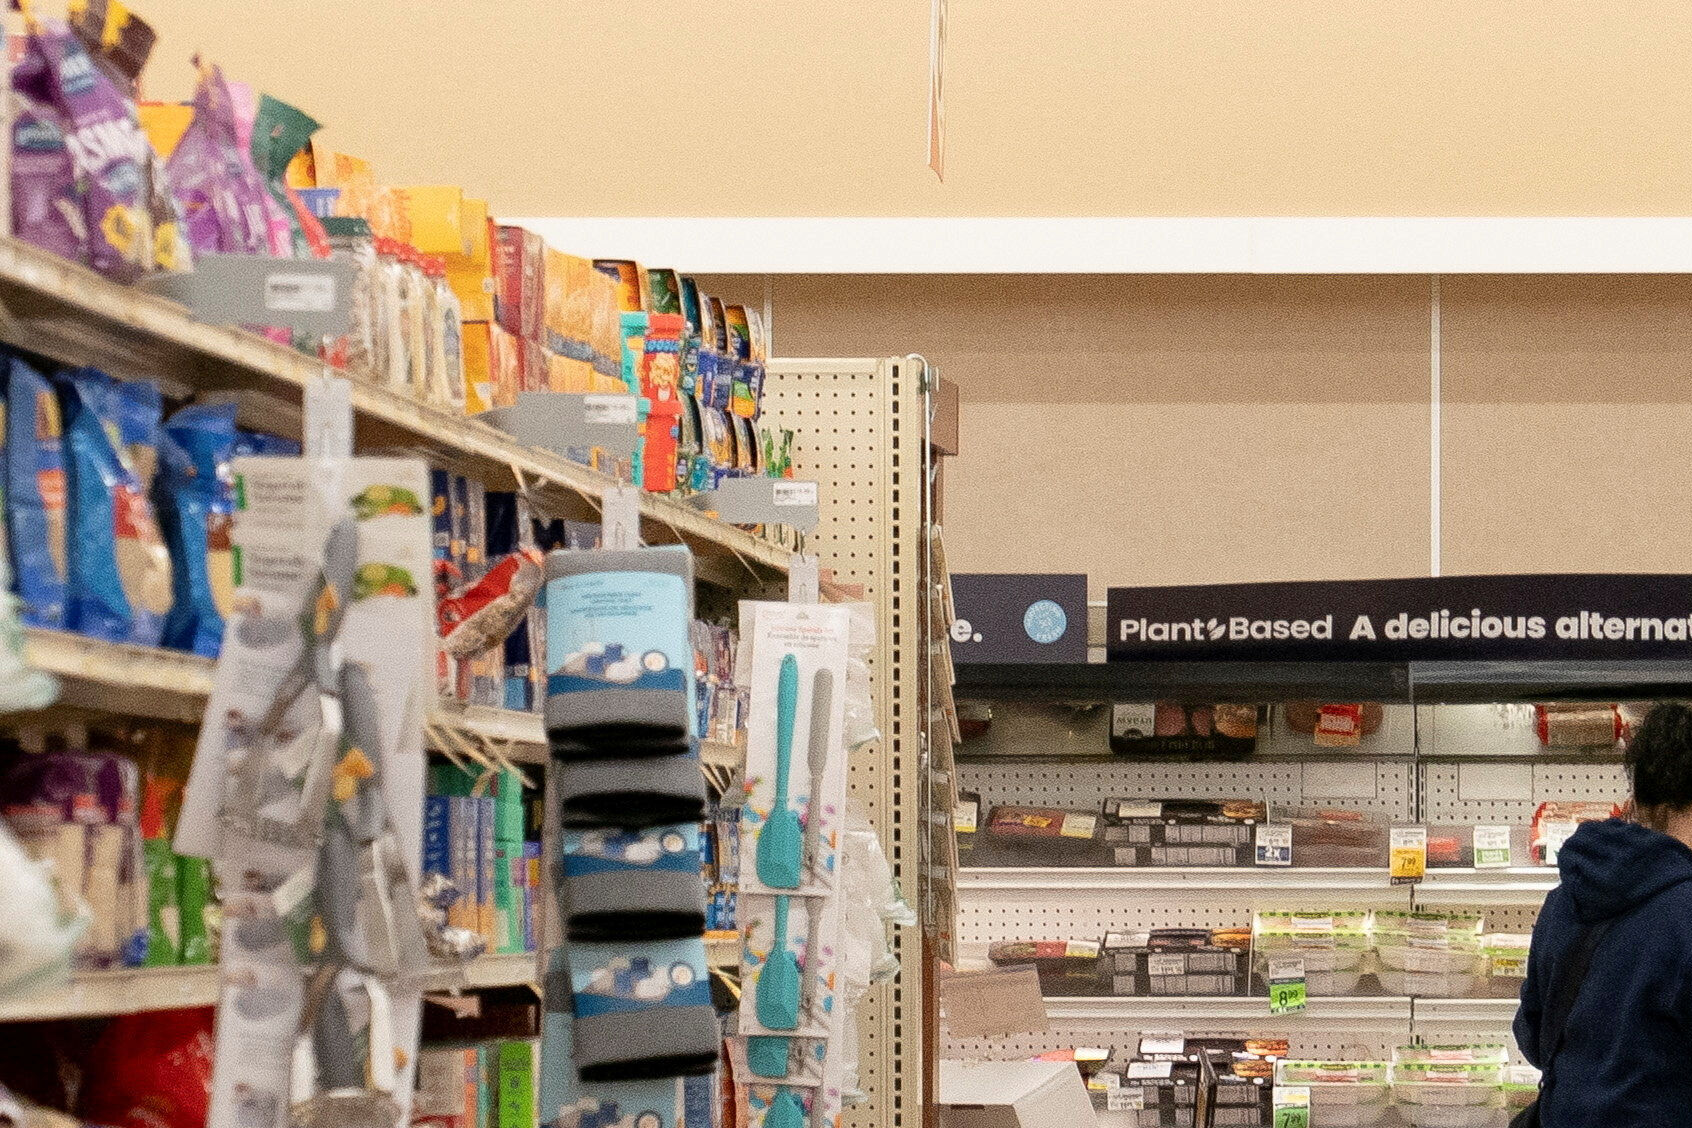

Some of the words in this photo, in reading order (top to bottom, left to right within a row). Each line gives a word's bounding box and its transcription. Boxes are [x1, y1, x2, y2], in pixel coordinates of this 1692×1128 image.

[1120, 617, 1205, 642] Plant
[1229, 614, 1333, 641] Based
[1349, 614, 1376, 640] A
[1384, 608, 1546, 639] delicious
